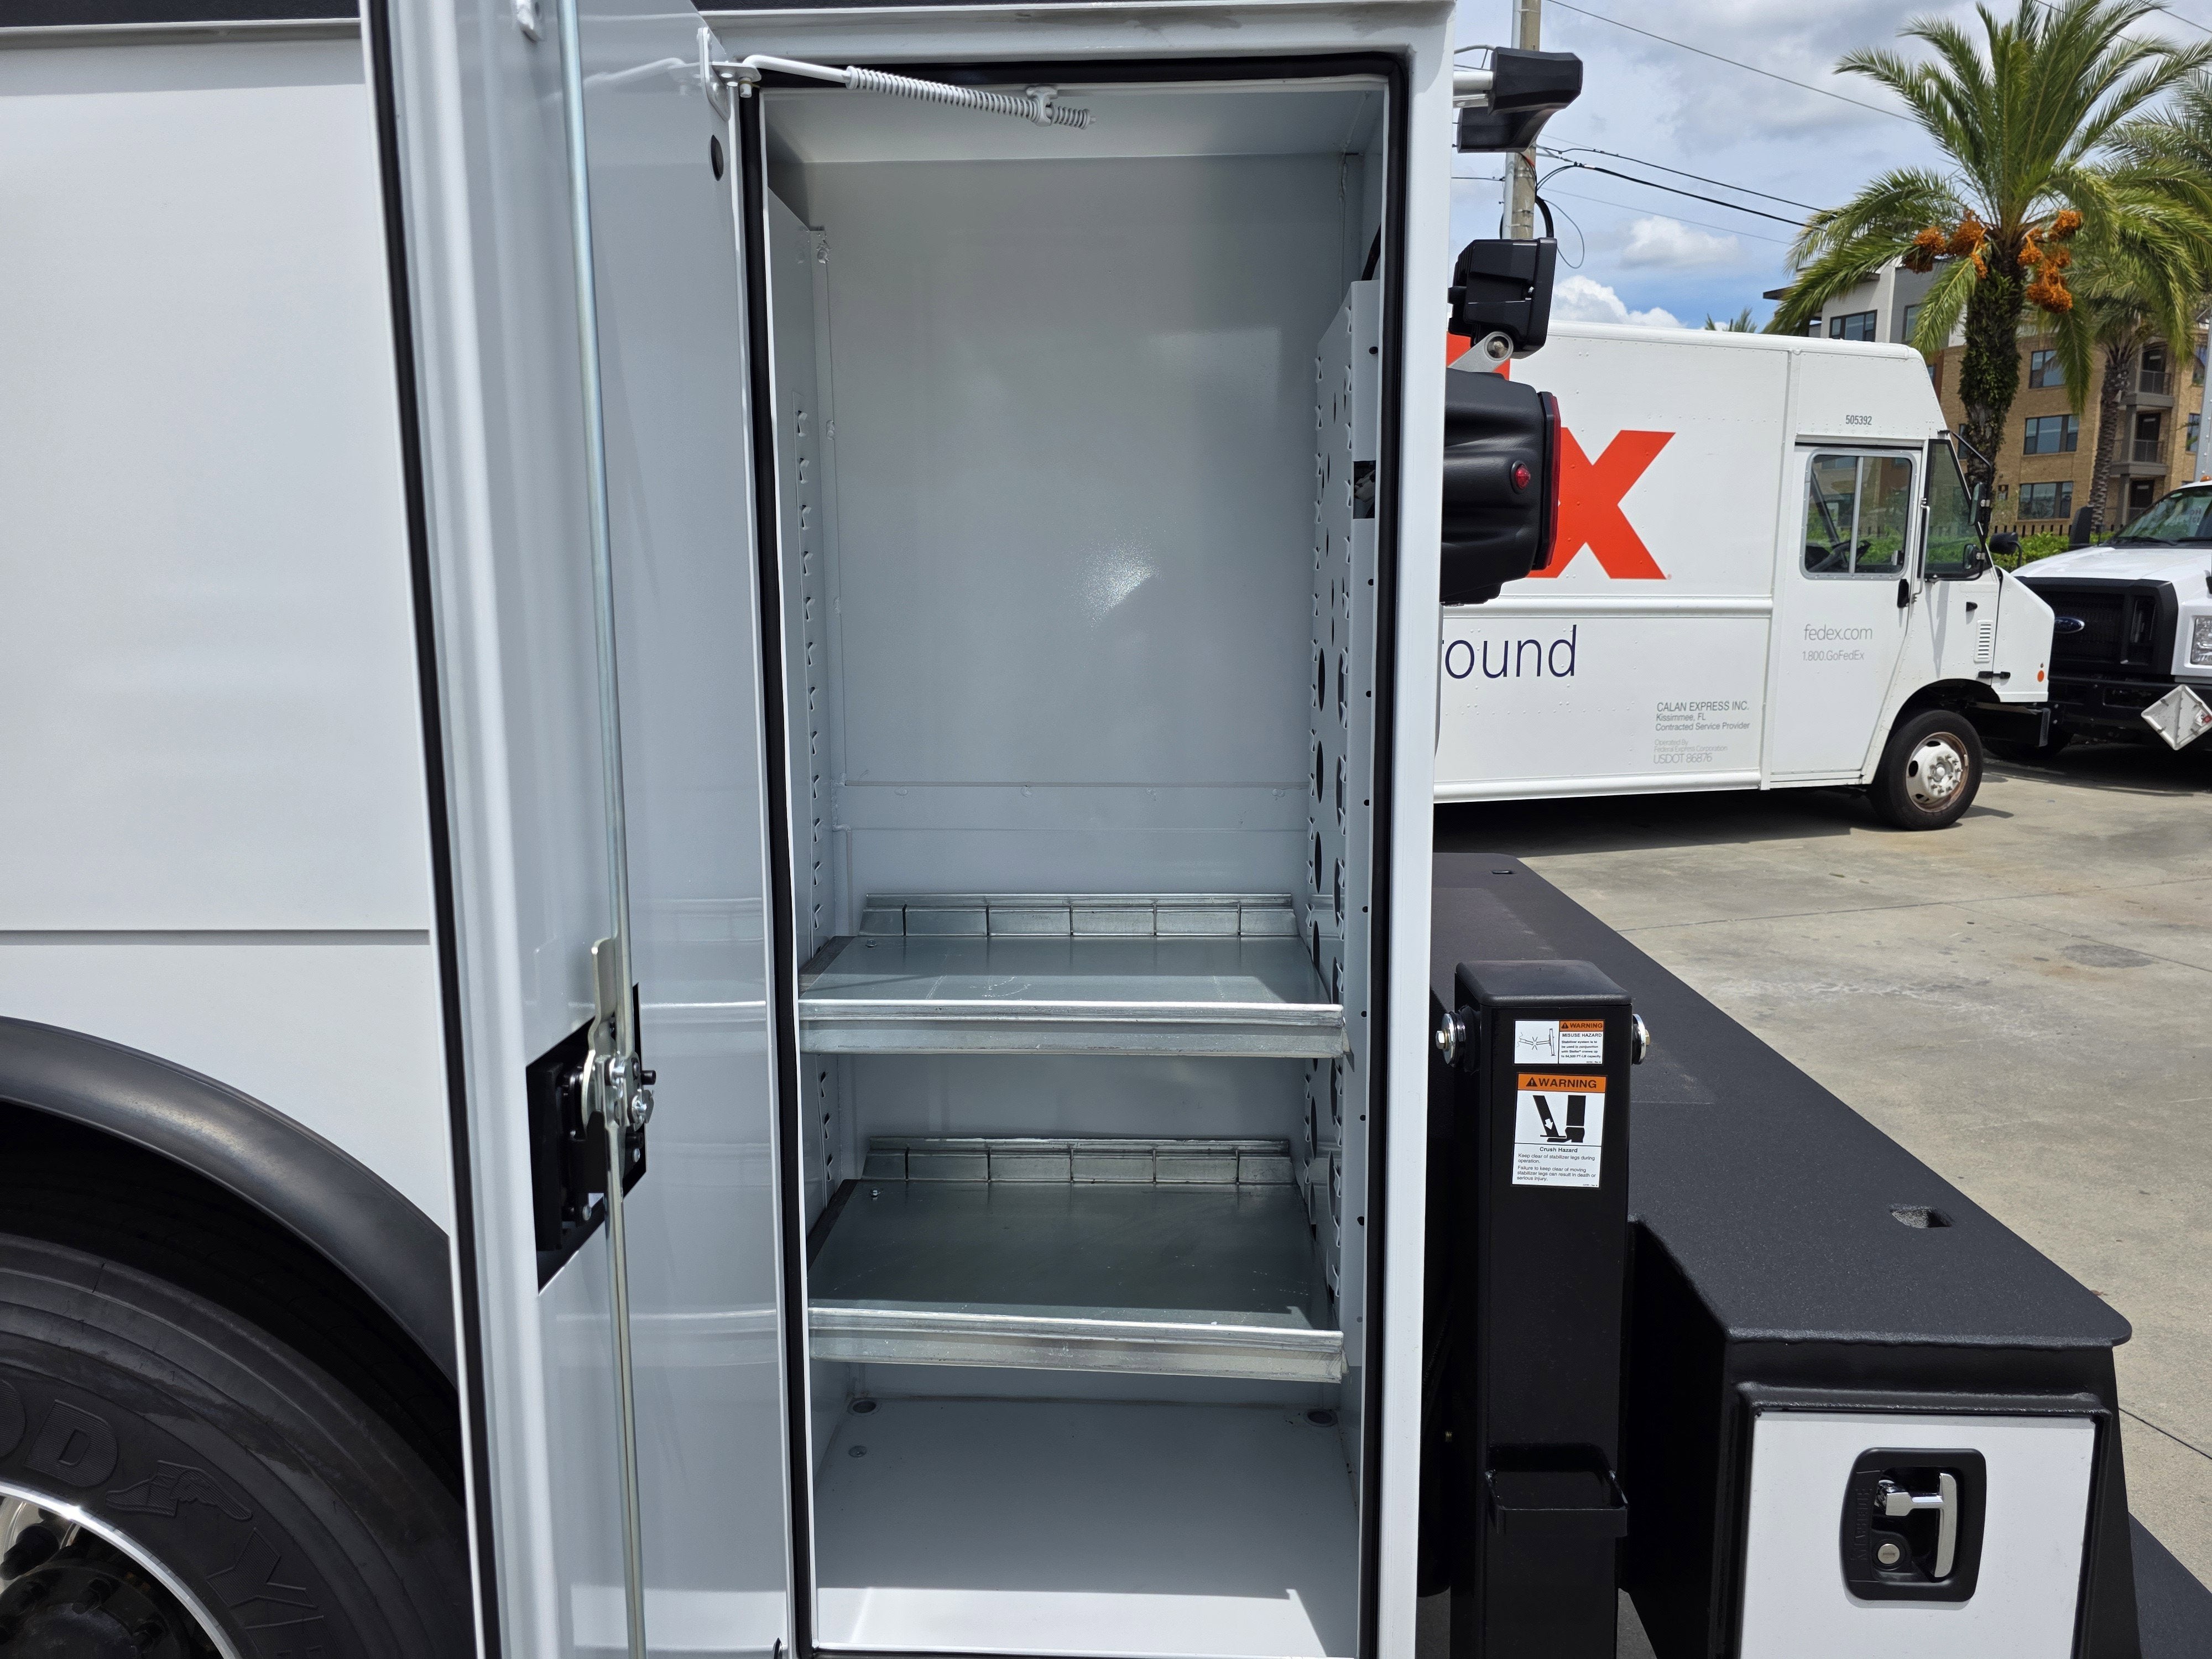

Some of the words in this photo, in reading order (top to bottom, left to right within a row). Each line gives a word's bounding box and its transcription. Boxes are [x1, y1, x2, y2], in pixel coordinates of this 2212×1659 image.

[1845, 415, 1872, 425] 505392
[1803, 624, 1872, 640] fedex.com
[1442, 624, 1577, 679] ound
[1802, 650, 1865, 661] 1.800.GoFedEx
[1657, 702, 1687, 712] CALAN
[1689, 701, 1730, 711] EXPRESS
[1731, 701, 1749, 711] INC.
[1653, 754, 1684, 764] USDOT
[1538, 1078, 1597, 1088] WARNING
